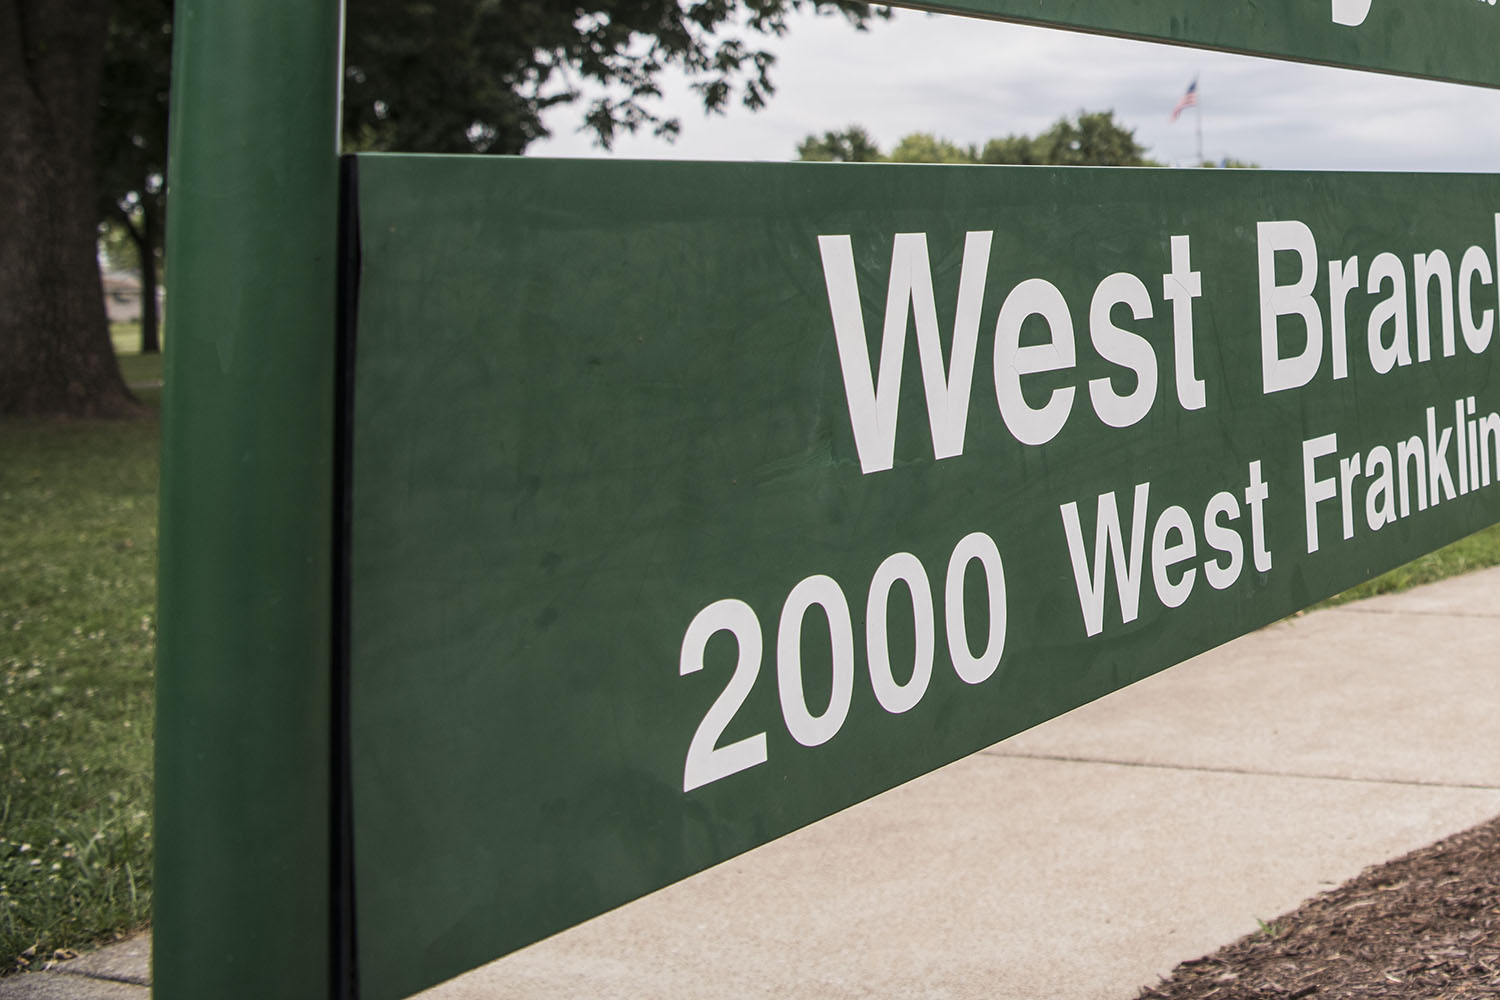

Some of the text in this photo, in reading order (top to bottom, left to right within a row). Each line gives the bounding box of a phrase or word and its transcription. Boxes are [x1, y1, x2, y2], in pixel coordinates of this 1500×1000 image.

[818, 231, 1206, 474] West
[680, 532, 1006, 792] 2000
[1060, 460, 1272, 637] West
